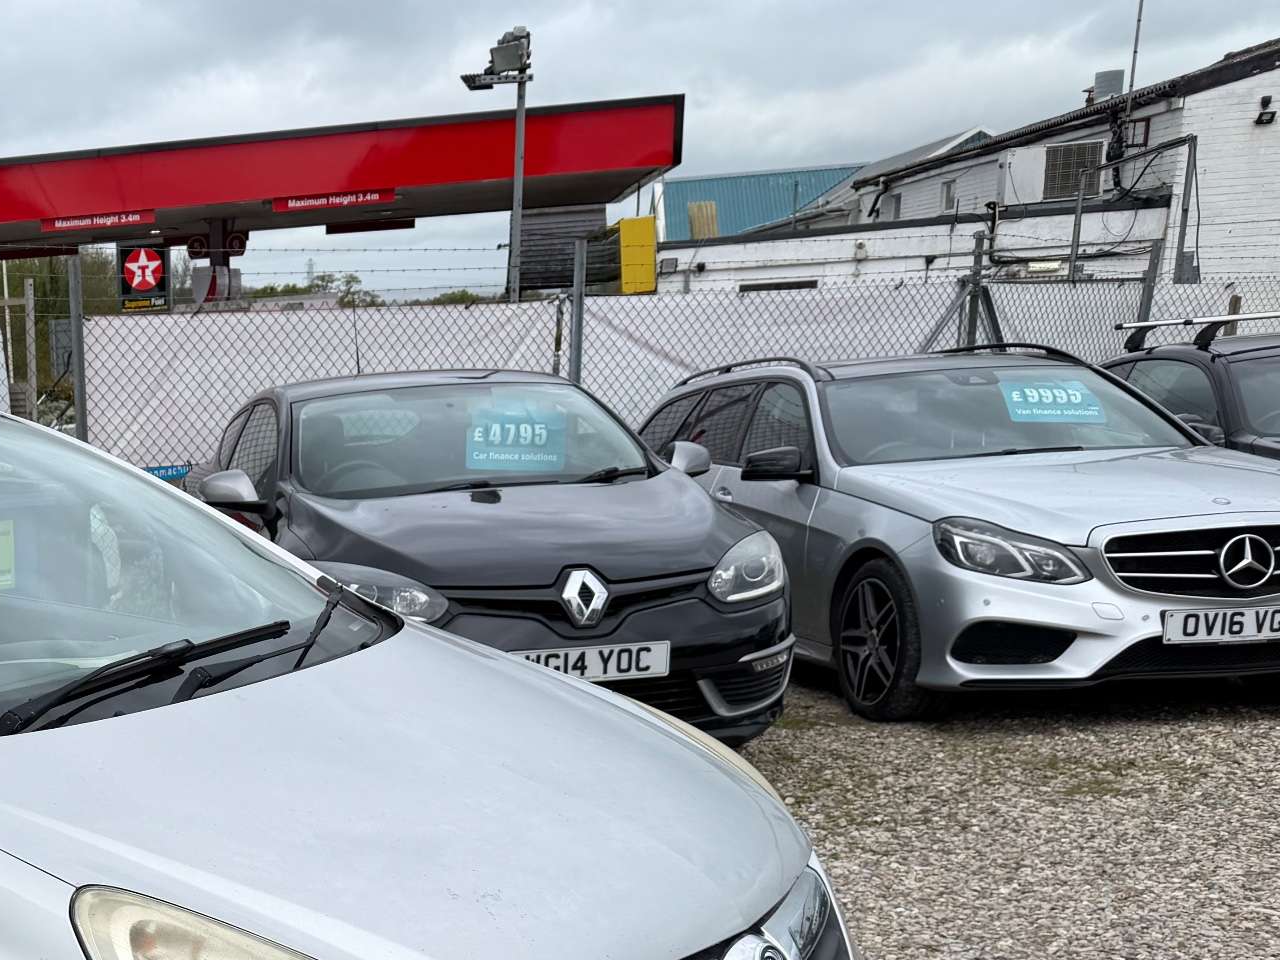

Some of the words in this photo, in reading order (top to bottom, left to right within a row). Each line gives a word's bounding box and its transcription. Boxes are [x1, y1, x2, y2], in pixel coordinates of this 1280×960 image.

[288, 197, 327, 208] Maximum
[328, 194, 357, 205] Height
[358, 192, 379, 201] 3.4m
[55, 217, 92, 228] Maximum
[93, 215, 119, 225] Height
[120, 213, 140, 222] 3.4m
[1015, 408, 1031, 416] Van
[1032, 407, 1061, 416] finance
[1063, 408, 1099, 416] solutions
[473, 423, 548, 446] £4795
[472, 451, 487, 460] Car
[489, 451, 520, 460] finance
[521, 452, 557, 462] solutions
[1182, 611, 1245, 637] OV16
[598, 646, 652, 675] YOC
